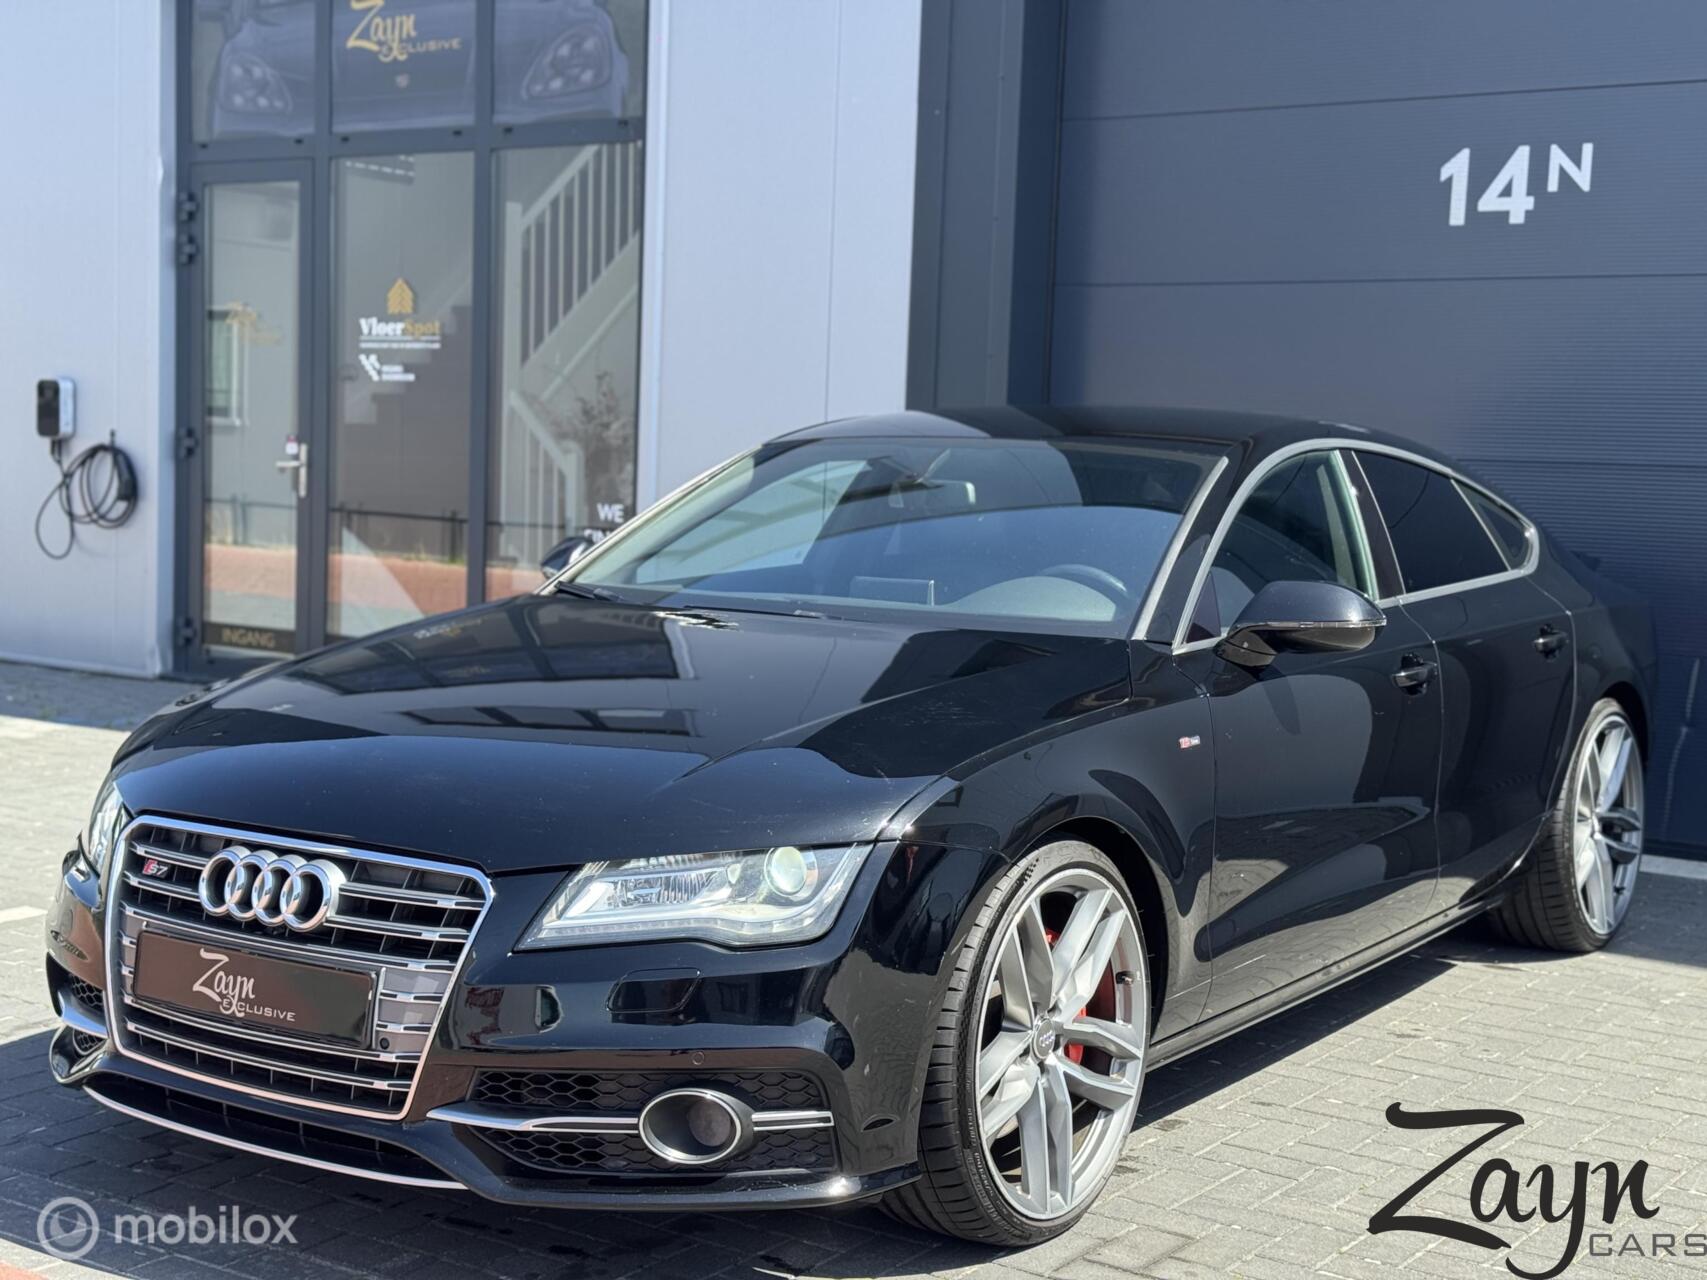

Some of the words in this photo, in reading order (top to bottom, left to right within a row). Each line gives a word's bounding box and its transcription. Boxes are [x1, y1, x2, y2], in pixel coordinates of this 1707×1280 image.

[346, 0, 417, 61] Zayn
[597, 503, 624, 523] WE
[146, 861, 169, 877] S7
[193, 948, 255, 1017] Zayn
